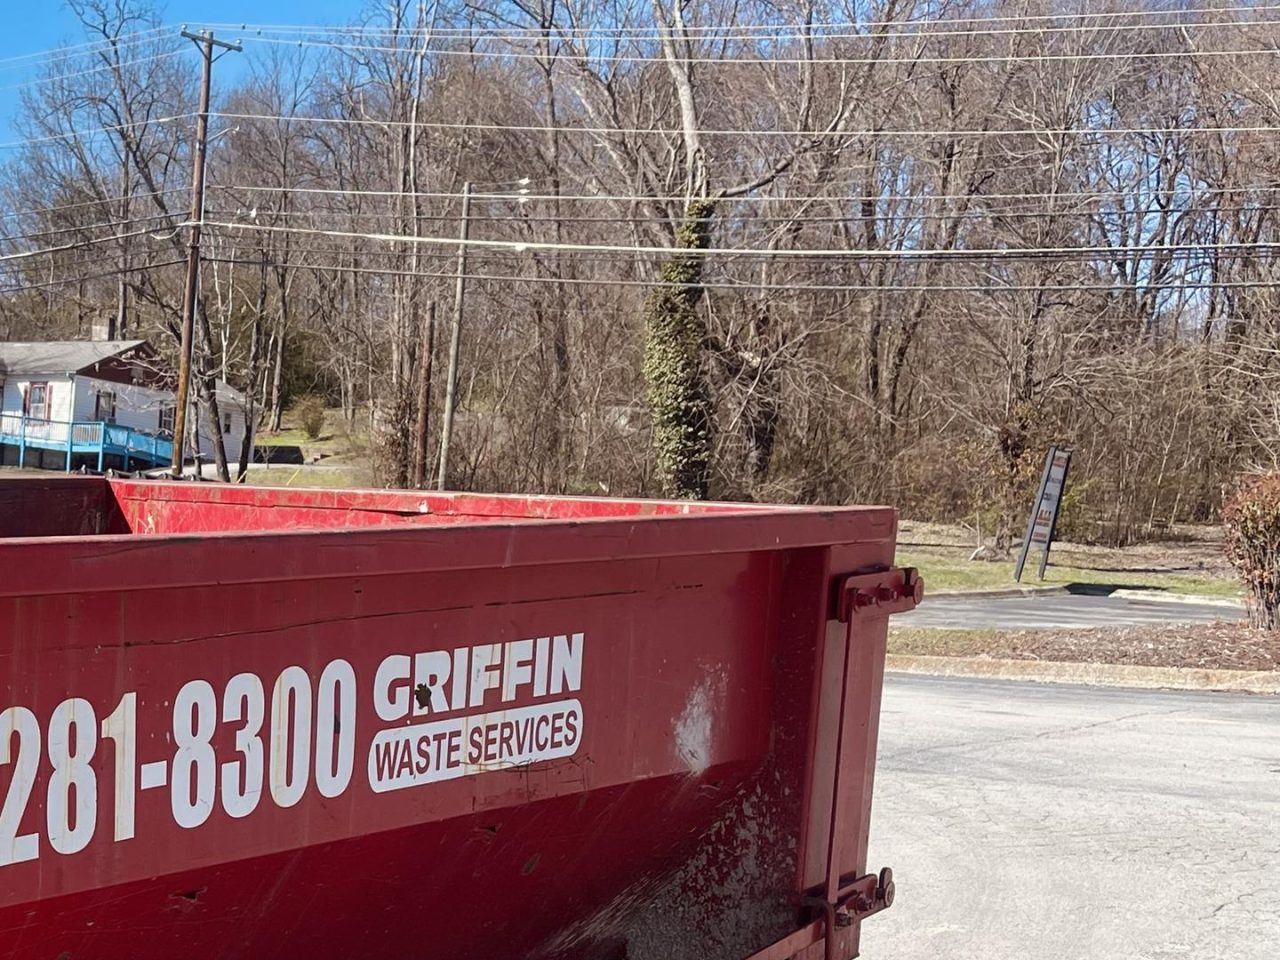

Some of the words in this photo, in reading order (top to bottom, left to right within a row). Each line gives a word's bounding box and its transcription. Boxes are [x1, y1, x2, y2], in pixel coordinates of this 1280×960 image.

[373, 632, 585, 722] GRIFFIN
[375, 730, 462, 782] WASTE
[468, 710, 578, 765] SERVICES
